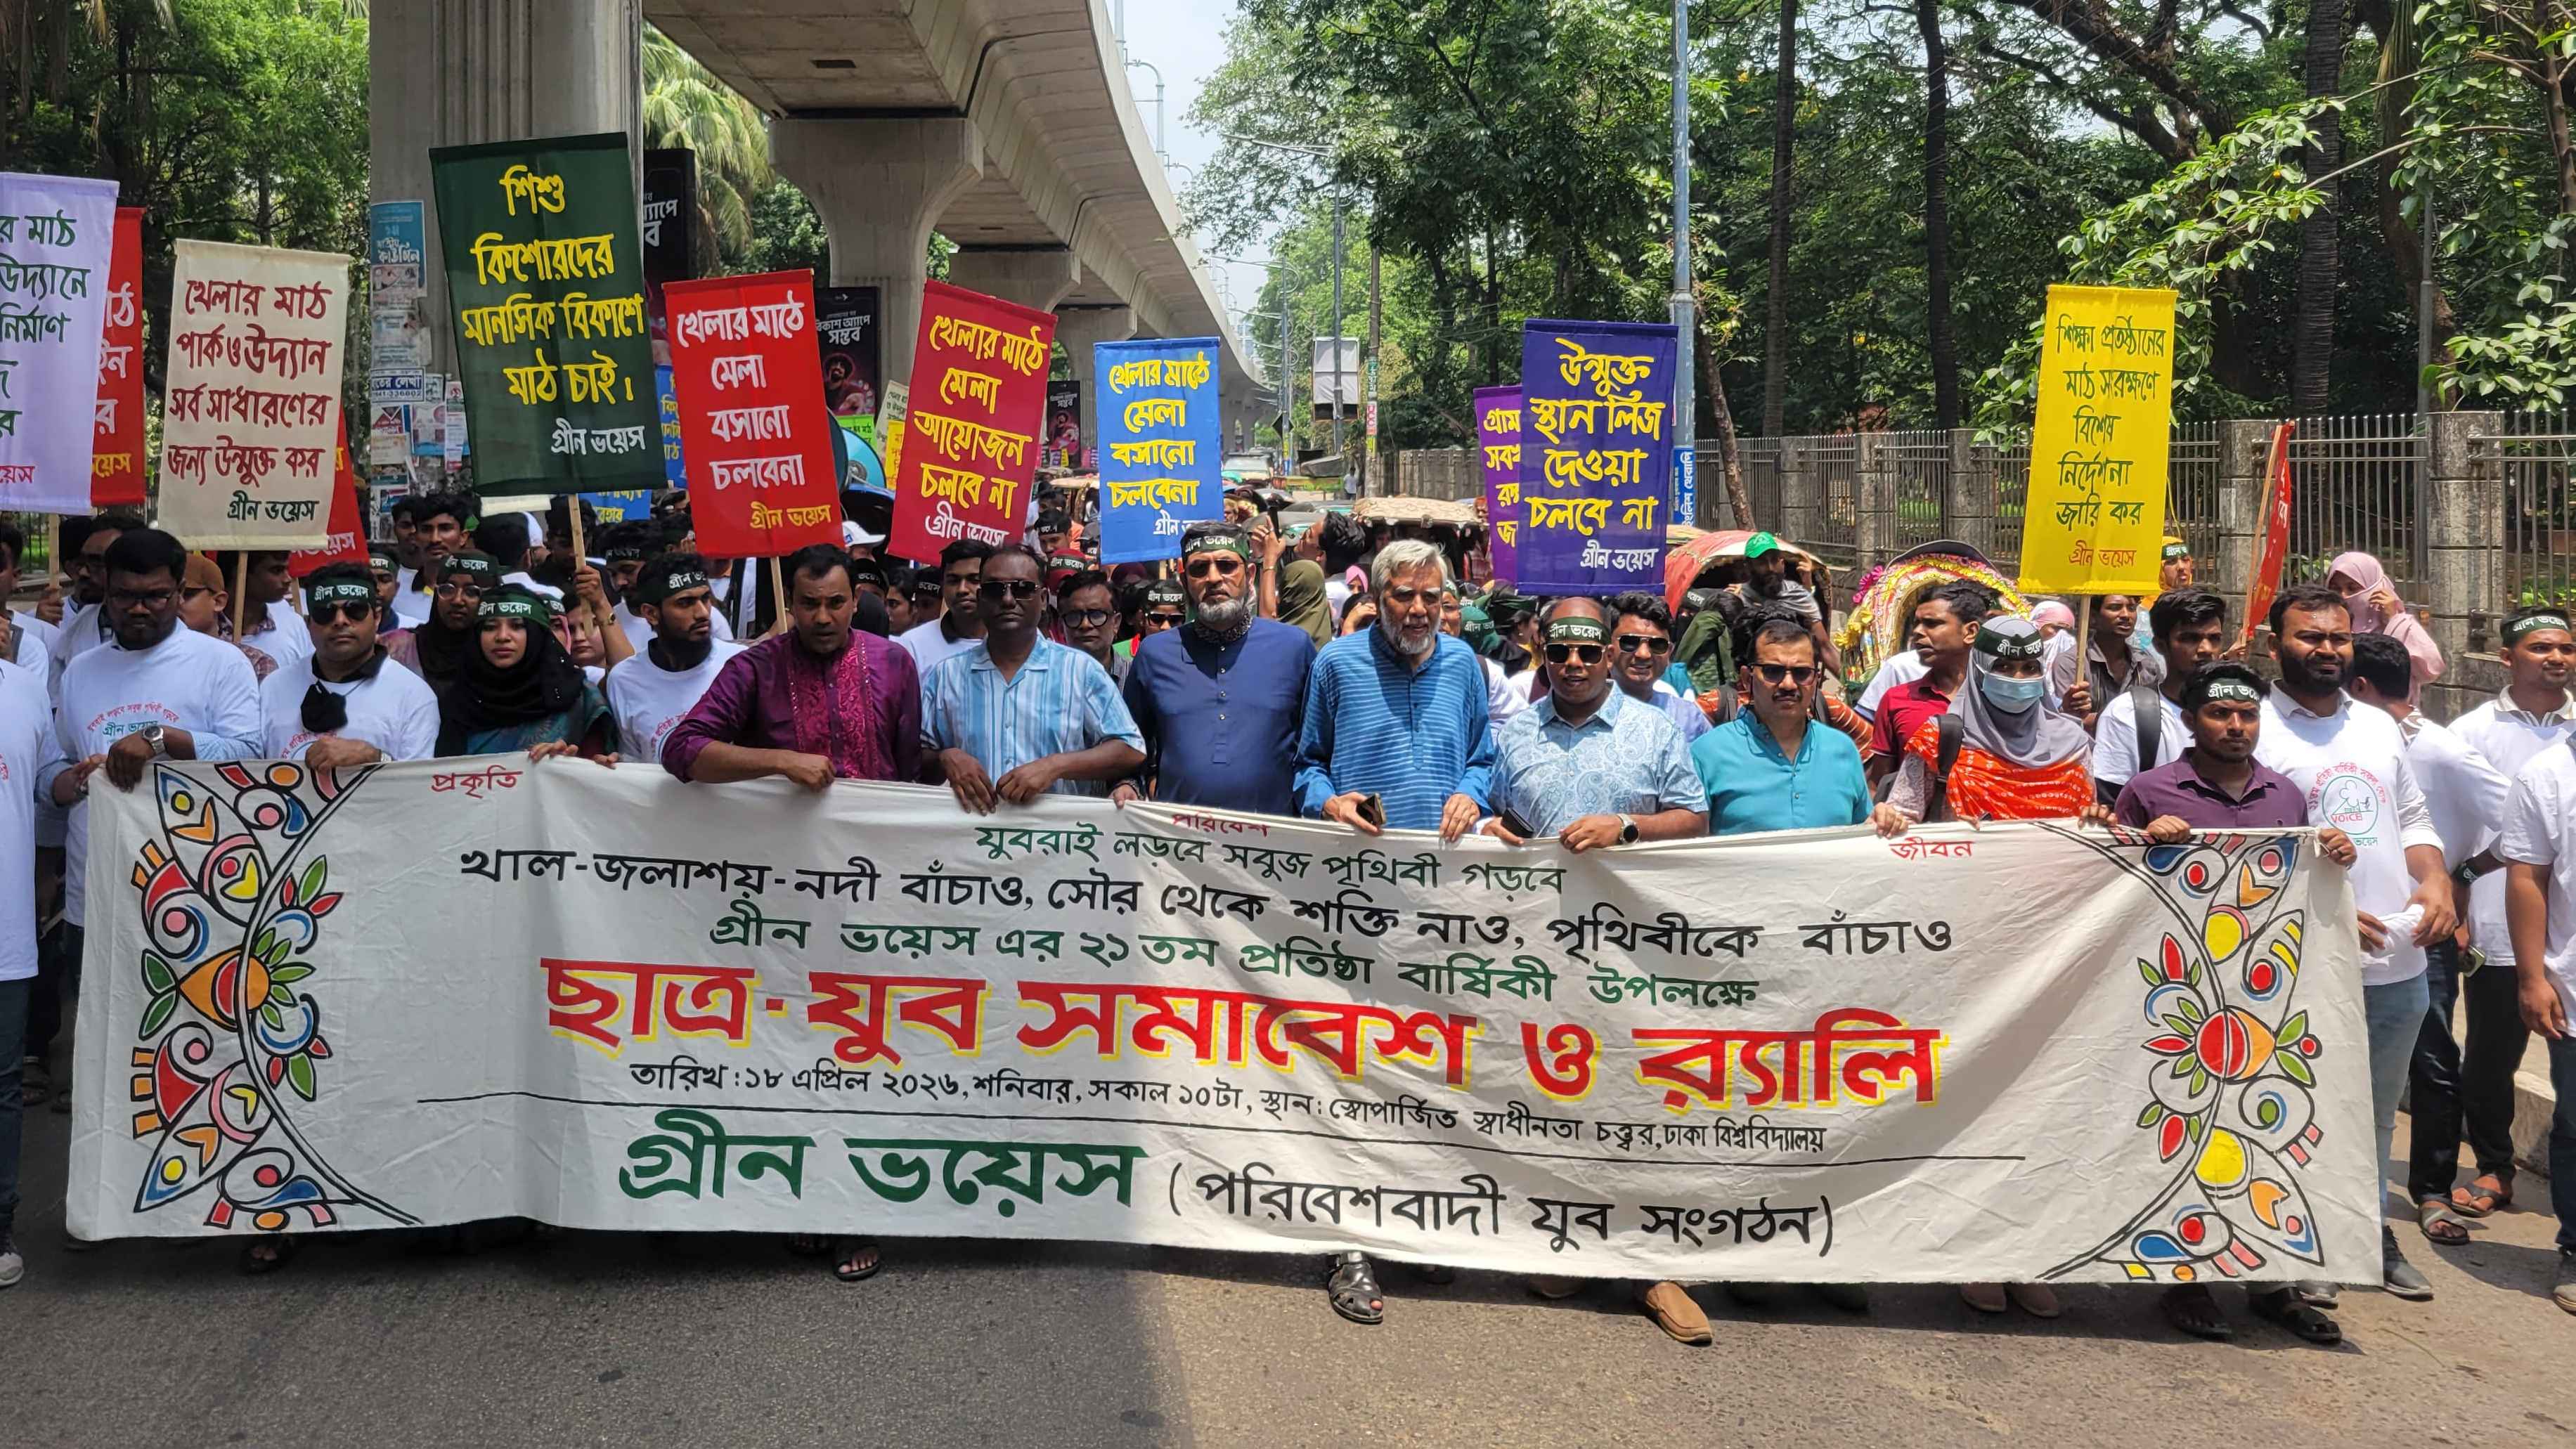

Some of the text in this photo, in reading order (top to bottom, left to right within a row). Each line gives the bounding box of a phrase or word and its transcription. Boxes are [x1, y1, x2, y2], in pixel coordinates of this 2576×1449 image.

[500, 165, 566, 216] শিশু
[25, 209, 77, 247] মাঠ
[470, 233, 616, 285] কিশোরদের
[185, 280, 332, 320] খেলার মাঠ
[461, 292, 645, 346] মানসিক বিকাশে
[676, 290, 805, 348] খেলার মাঠে
[176, 324, 225, 368] পার্ক
[244, 324, 332, 380] উদ্যান
[828, 325, 862, 345] সম্ভব
[928, 314, 1049, 376] খেলার মাঠে
[2056, 313, 2096, 354] শিক্ষা
[503, 348, 559, 405] মাঠ
[711, 353, 768, 391] মেলা
[1108, 350, 1211, 394] খেলার মাঠে
[1555, 337, 1654, 396] উন্মুক্ত
[2063, 361, 2095, 400] মাঠ
[169, 383, 333, 428] সর্ব সাধারণের
[940, 366, 1003, 415] মেলা
[706, 404, 791, 443] বসানো
[1124, 398, 1187, 434] মেলা
[1529, 390, 1666, 444] স্থান লিজ
[2073, 404, 2121, 444] বিশেষ
[551, 417, 588, 456] গ্রীন
[591, 425, 647, 455] ভয়েস
[914, 410, 1033, 471] আয়োজন
[1109, 439, 1196, 470] বসানো
[167, 444, 212, 486] জন্য
[214, 436, 278, 488] উন্মুক্ত
[284, 448, 326, 479] কর
[708, 453, 806, 491] চলবেনা
[1543, 448, 1648, 488] দেওয়া
[2057, 450, 2134, 493] নির্দেশনা
[227, 490, 320, 523] গ্রীন ভয়েস
[920, 462, 1018, 519] চলবে না
[1106, 478, 1200, 509] চলবেনা
[749, 501, 832, 531] গ্রীন ভয়েস
[924, 500, 966, 540] গ্রীন
[1153, 509, 1180, 536] গ্রীন
[1524, 496, 1613, 536] চলবে
[1621, 495, 1659, 531] না
[2056, 492, 2145, 531] জারি কর
[1579, 539, 1659, 573] গ্রীন ভয়েস
[2069, 540, 2137, 568] গ্রীন ভয়েস
[337, 585, 369, 599] ভয়েস
[669, 571, 692, 589] গ্রীন
[498, 602, 532, 615] ভয়েস
[1569, 624, 1603, 641] ভয়েস
[1997, 638, 2022, 656] গ্রীন
[2208, 682, 2234, 698] গ্রীন
[103, 722, 125, 736] গ্রীন
[432, 765, 522, 799] প্রকৃতি
[1172, 810, 1271, 837] পরিবেশ
[974, 821, 1567, 902] যুবরাই লড়বে সবুজ পৃথিবী গড়বে
[1890, 837, 1974, 861] জীবন
[900, 859, 1033, 911] বাঁচাও,
[1048, 867, 1143, 915] সৌর
[1160, 884, 1269, 921] থেকে
[1290, 889, 1399, 937] শক্তি
[1416, 911, 1525, 950] নাও,
[1546, 902, 1763, 964] পৃথিবীকে
[1798, 909, 1953, 956] বাঁচাও
[710, 898, 1759, 1008] গ্রীন ভয়েস এর ২১ তম প্রতিষ্ঠা বার্ষিকী উপলক্ষে
[1017, 980, 1484, 1093] সমাবেশ
[1520, 1020, 1603, 1103] ও
[792, 1058, 871, 1093] এপ্রিল
[1087, 1079, 1171, 1105] সকাল
[1473, 1100, 1581, 1137] স্বাধীনতা
[1712, 1116, 1827, 1153] বিশ্ববিদ্যালয়
[619, 1108, 817, 1200] গ্রীন
[843, 1138, 1149, 1218] ভয়েস
[1527, 1197, 1615, 1252] যুব
